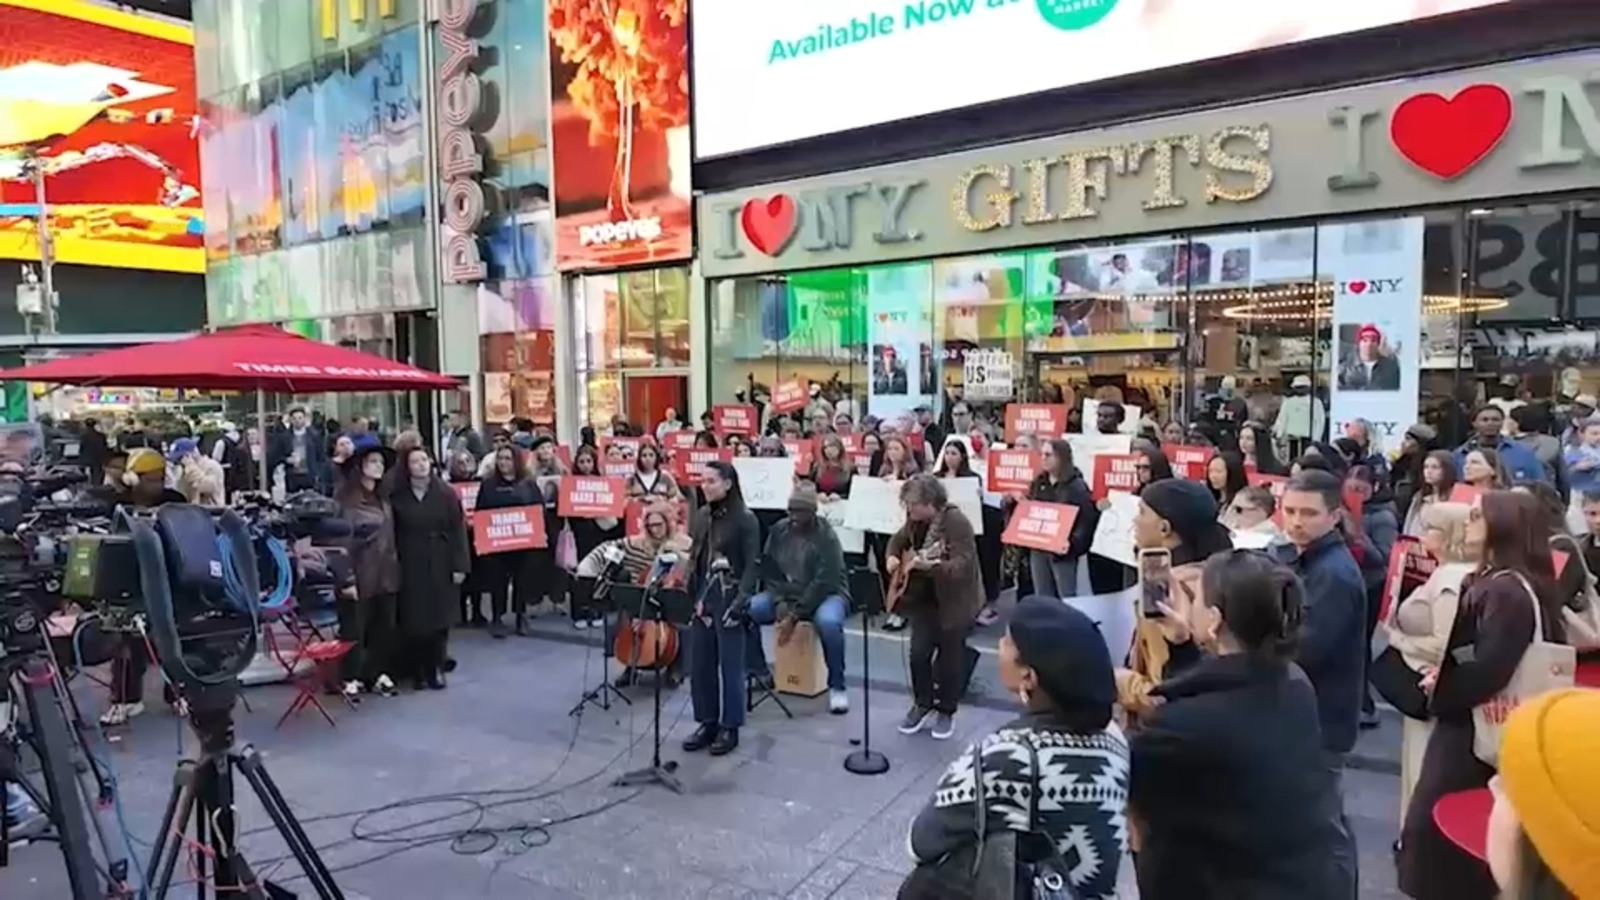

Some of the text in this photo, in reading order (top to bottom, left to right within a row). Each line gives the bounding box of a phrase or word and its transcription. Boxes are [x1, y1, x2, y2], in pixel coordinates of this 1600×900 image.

[768, 0, 975, 64] Available Now
[712, 203, 745, 259] I
[952, 122, 1274, 231] GIFTS
[1327, 105, 1381, 192] I
[1339, 277, 1404, 294] I NY
[233, 363, 429, 379] TIMES SQUARE
[965, 365, 985, 385] US
